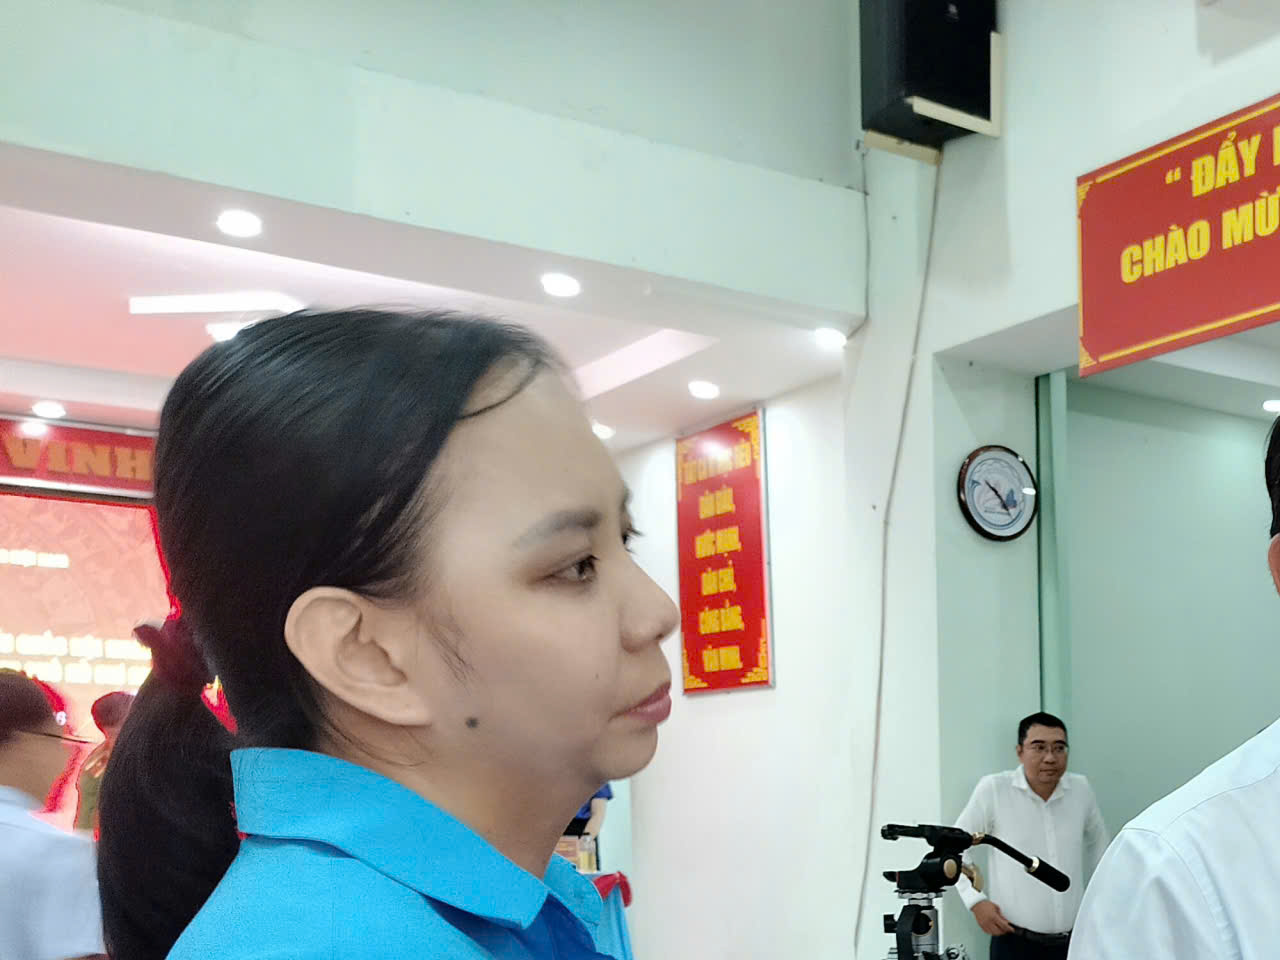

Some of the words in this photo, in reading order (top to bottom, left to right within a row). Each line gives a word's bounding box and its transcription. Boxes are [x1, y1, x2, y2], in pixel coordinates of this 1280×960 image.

[1191, 131, 1261, 197] ĐẨY
[1120, 220, 1211, 284] CHÀO
[3, 436, 155, 481] VINH
